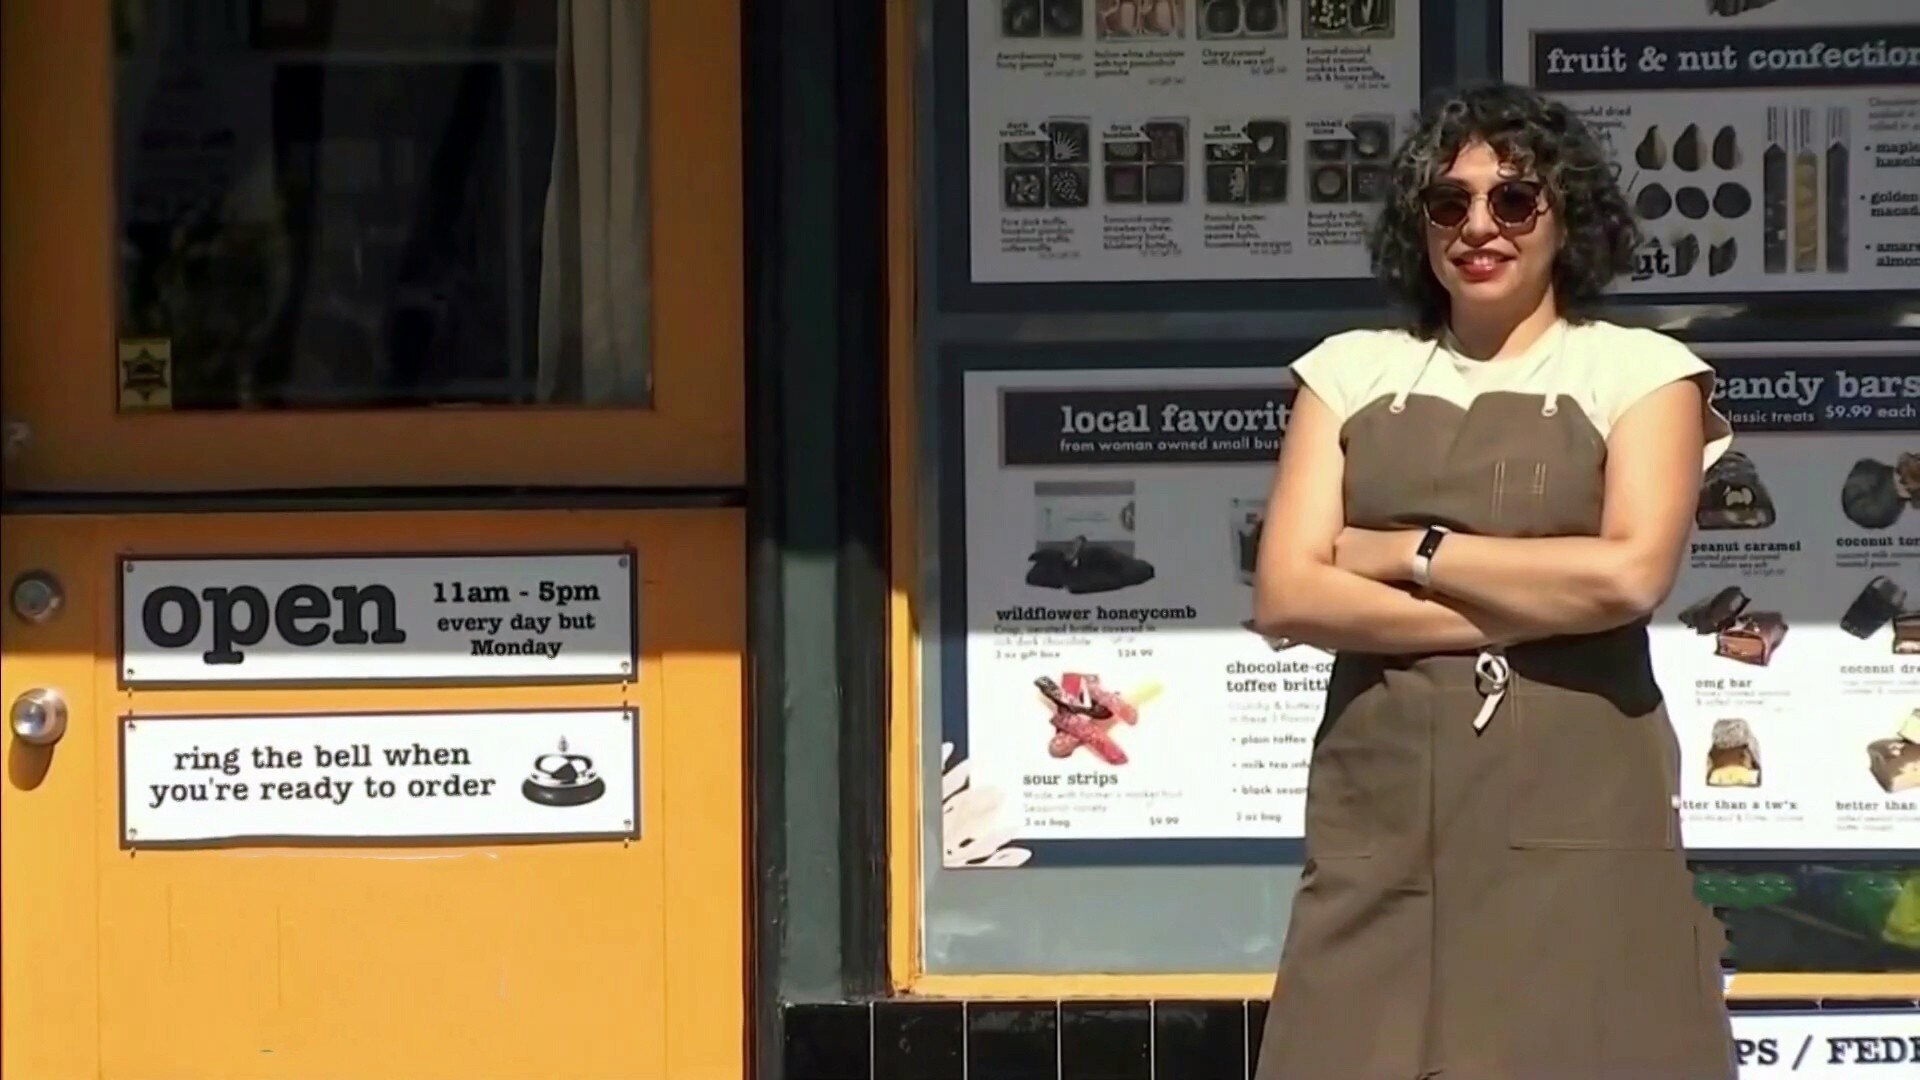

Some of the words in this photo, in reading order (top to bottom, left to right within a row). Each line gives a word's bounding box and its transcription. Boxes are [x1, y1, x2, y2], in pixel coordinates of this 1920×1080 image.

[1546, 45, 1627, 74] fruit
[1638, 46, 1668, 72] &
[1678, 45, 1738, 71] nut
[1870, 190, 1919, 206] golden
[1713, 370, 1824, 406] candy
[1836, 370, 1920, 399] bars
[1061, 405, 1150, 434] local
[1161, 401, 1292, 433] favorit
[1727, 409, 1766, 423] lassic
[1772, 411, 1814, 423] treats
[1826, 404, 1872, 419] $9.99
[1877, 404, 1916, 419] each
[1060, 438, 1096, 453] from
[1099, 440, 1152, 452] woman
[1158, 438, 1207, 451] owned
[1212, 436, 1249, 450] small
[1691, 542, 1740, 554] peanut
[1744, 540, 1801, 552] caramel
[1836, 537, 1893, 547] coconut
[433, 582, 510, 604] 11am
[538, 581, 601, 607] 5pm
[997, 605, 1090, 622] wildflower
[1096, 604, 1197, 625] honeycomb
[142, 582, 406, 665] open
[437, 615, 501, 636] every
[510, 613, 550, 635] day
[559, 612, 596, 631] but
[471, 638, 563, 659] Monday
[1840, 664, 1894, 674] coconut
[1226, 679, 1277, 693] toffee
[1695, 679, 1725, 690] omg
[1729, 677, 1752, 688] bar
[1240, 733, 1270, 746] plain
[1273, 733, 1307, 744] toffee
[174, 746, 240, 777] ring
[252, 745, 303, 770] the
[315, 744, 372, 768] bell
[384, 744, 471, 767] when
[1022, 774, 1061, 786] sour
[1067, 771, 1119, 788] strips
[149, 777, 249, 809] you're
[260, 776, 352, 806] ready
[366, 777, 396, 800] to
[408, 774, 496, 798] order
[1241, 785, 1271, 796] black
[1715, 800, 1747, 810] than
[1752, 802, 1760, 810] a
[1836, 800, 1880, 811] better
[1885, 800, 1918, 811] than
[1791, 1034, 1813, 1071] /
